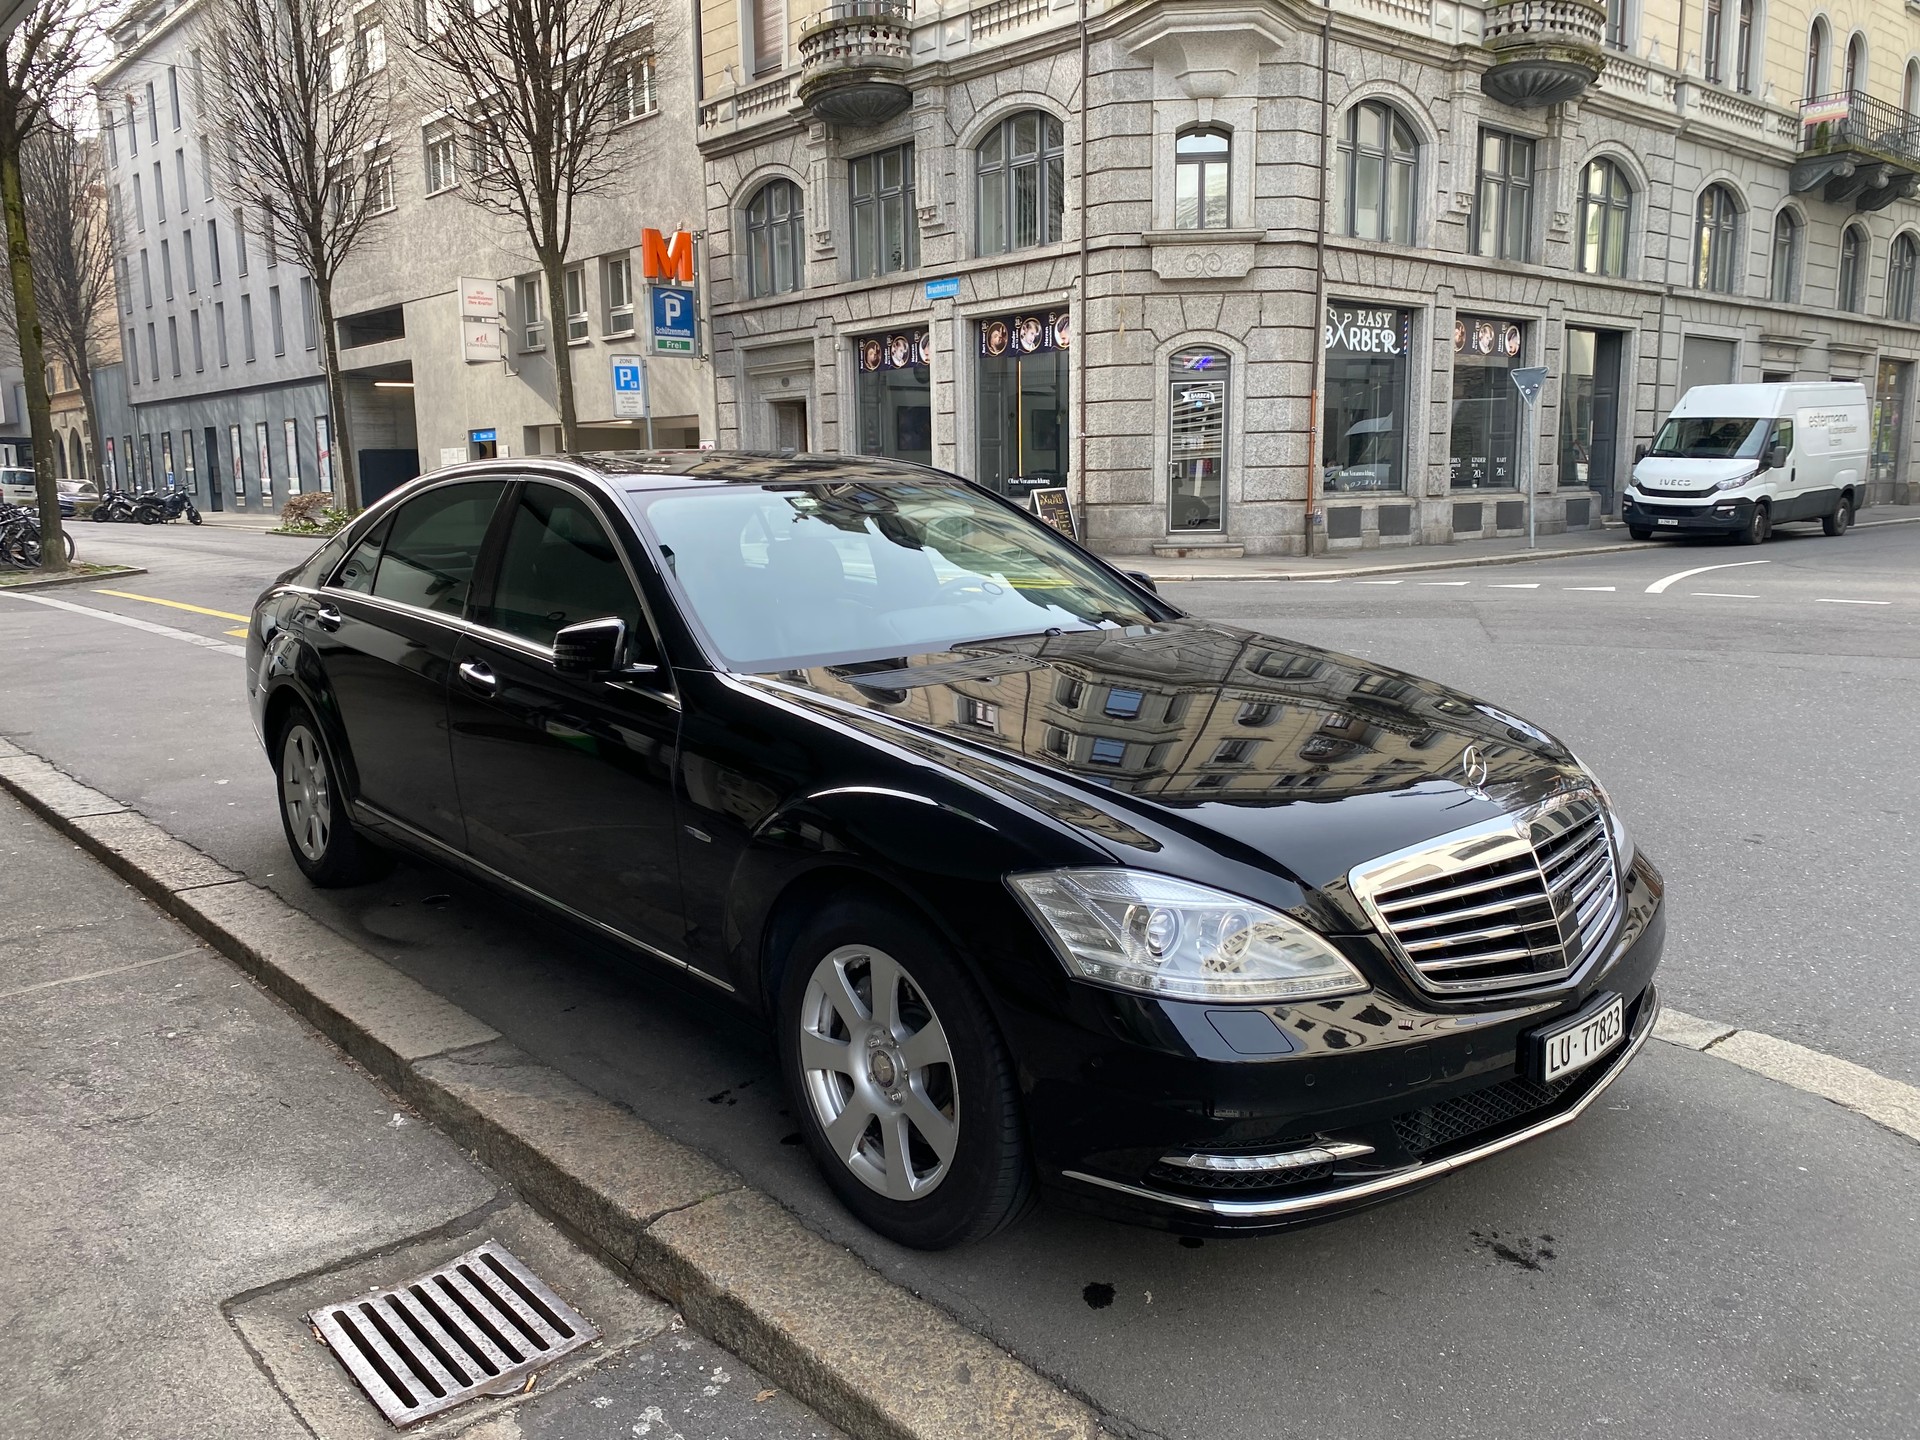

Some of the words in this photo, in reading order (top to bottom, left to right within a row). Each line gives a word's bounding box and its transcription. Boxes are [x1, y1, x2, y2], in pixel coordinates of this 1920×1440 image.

[642, 228, 693, 281] M
[665, 298, 681, 327] P
[1356, 309, 1392, 329] EASY
[655, 326, 691, 337] Schützenmatte
[666, 340, 682, 349] Frei
[619, 368, 632, 387] P
[1659, 479, 1692, 487] IVECO
